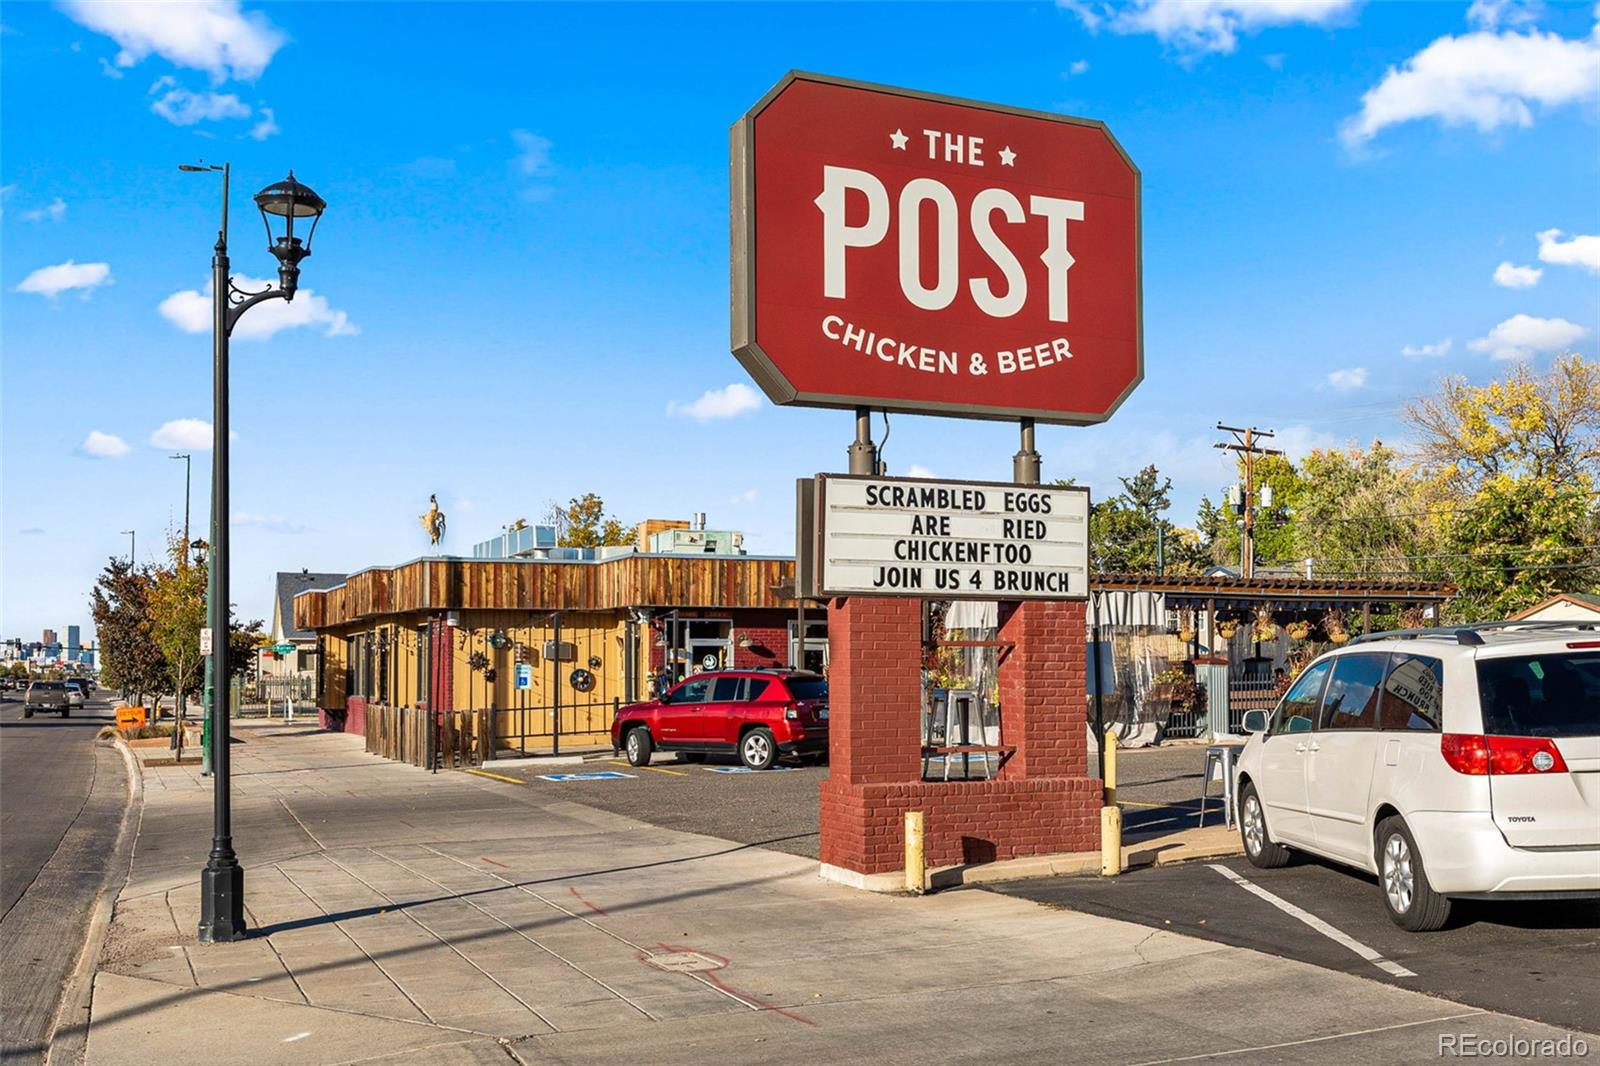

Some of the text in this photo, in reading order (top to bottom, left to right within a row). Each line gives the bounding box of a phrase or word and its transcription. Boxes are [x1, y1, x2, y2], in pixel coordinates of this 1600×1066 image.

[923, 129, 984, 166] THE
[814, 165, 1084, 322] POST
[822, 315, 1073, 375] CHICKEN & BEER
[866, 484, 1052, 514] SCRAMBLED EGGS
[911, 514, 1047, 540] ARE RIED
[873, 566, 1069, 592] JOIN US 4 BRUNCH
